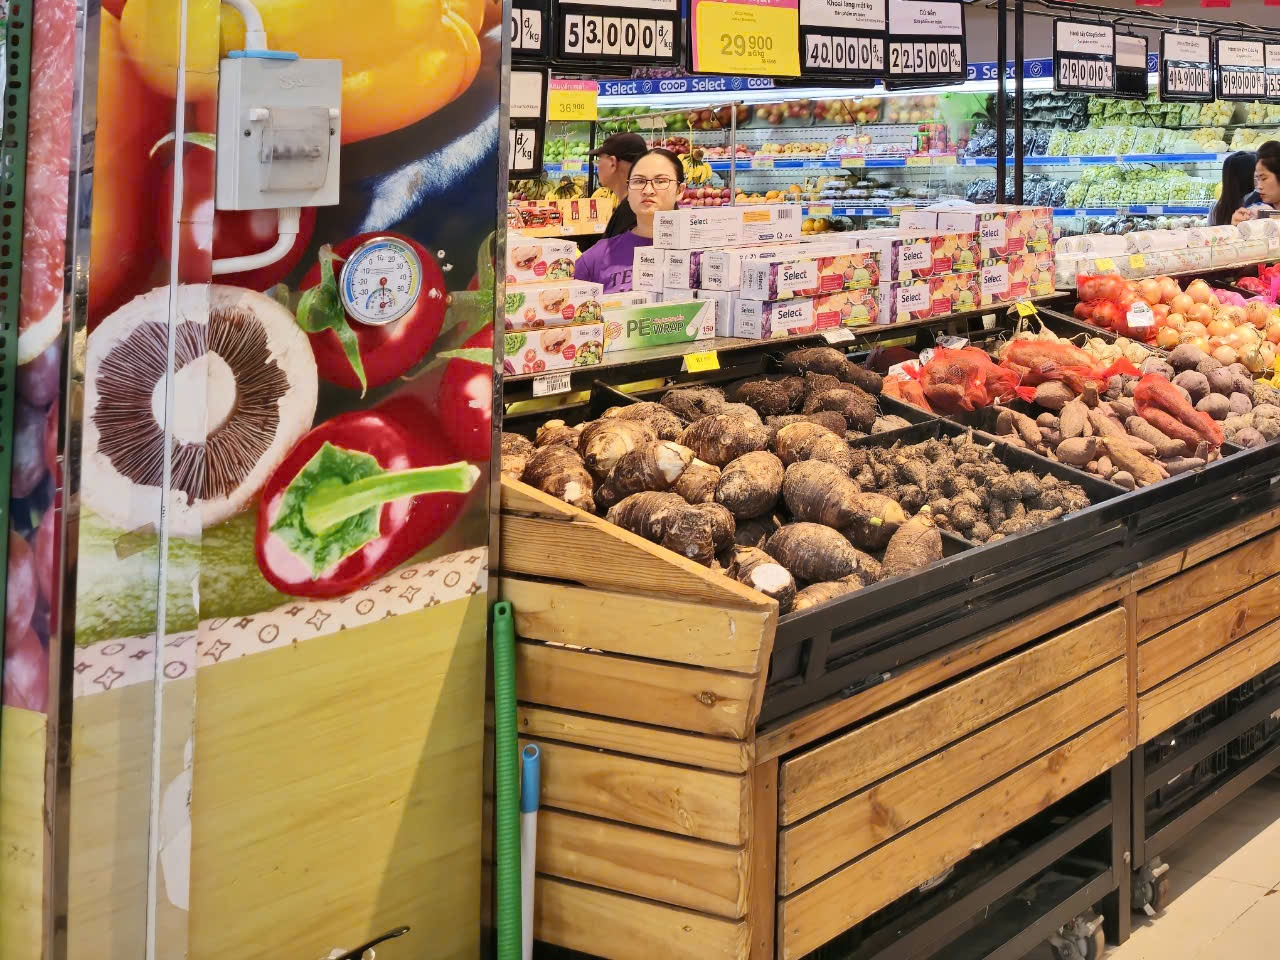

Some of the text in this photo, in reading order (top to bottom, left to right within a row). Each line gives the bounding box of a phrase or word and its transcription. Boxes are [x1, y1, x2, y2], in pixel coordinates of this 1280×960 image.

[568, 19, 653, 49] 53.000
[810, 43, 870, 64] 40.000
[891, 48, 948, 69] 22.500
[1062, 62, 1103, 81] 29.000
[660, 78, 725, 91] COOP Select
[1223, 74, 1256, 89] 99.000
[605, 82, 638, 95] Select
[690, 217, 709, 226] Select
[982, 228, 999, 238] Select
[903, 251, 923, 261] Select
[783, 270, 808, 281] Select
[983, 274, 1002, 284] Select
[901, 292, 921, 303] Select
[778, 308, 803, 319] Select
[627, 318, 650, 338] PE
[653, 321, 684, 334] WRAP
